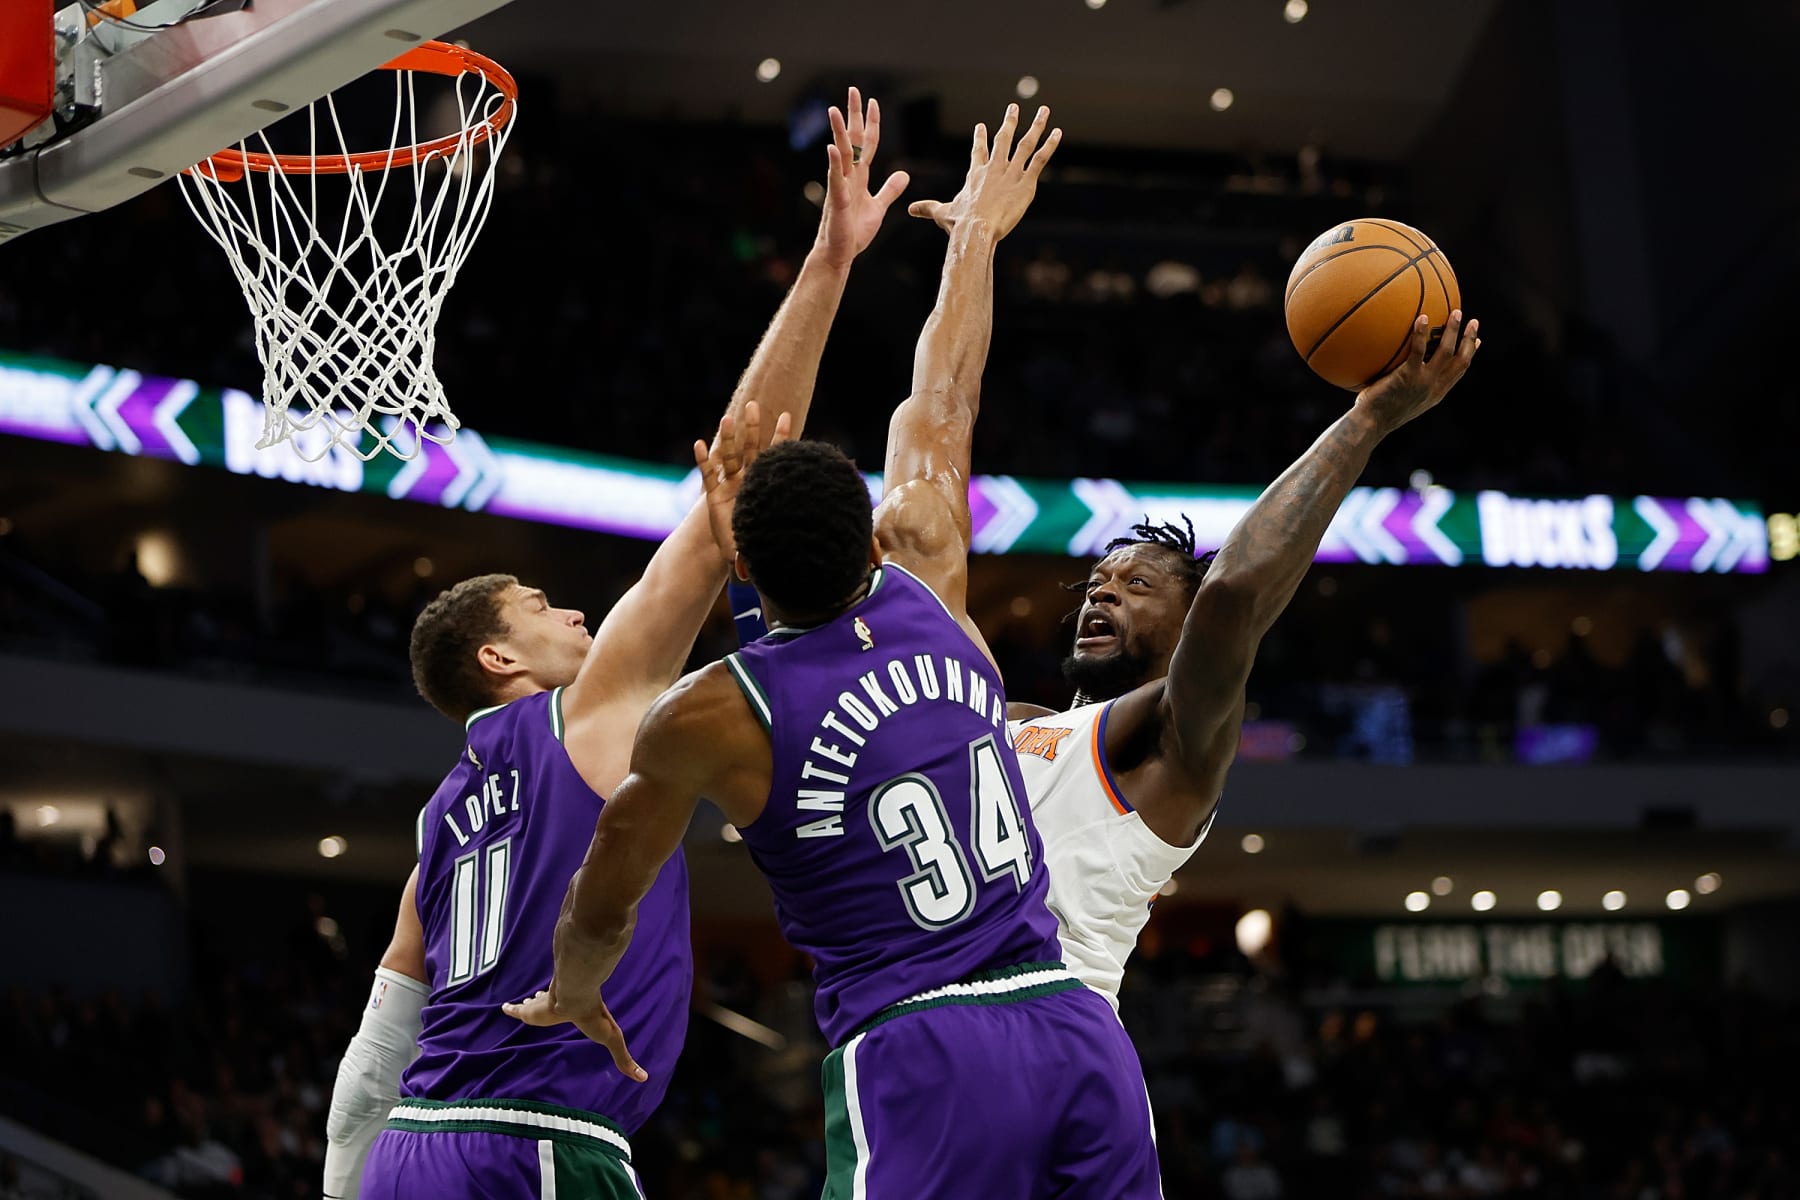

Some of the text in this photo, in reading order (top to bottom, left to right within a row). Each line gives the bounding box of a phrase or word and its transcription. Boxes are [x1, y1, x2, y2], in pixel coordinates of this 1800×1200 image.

[1014, 725, 1073, 761] ORK
[444, 769, 519, 847] LOPEZ
[867, 732, 1033, 931] 34
[447, 836, 511, 988] 11
